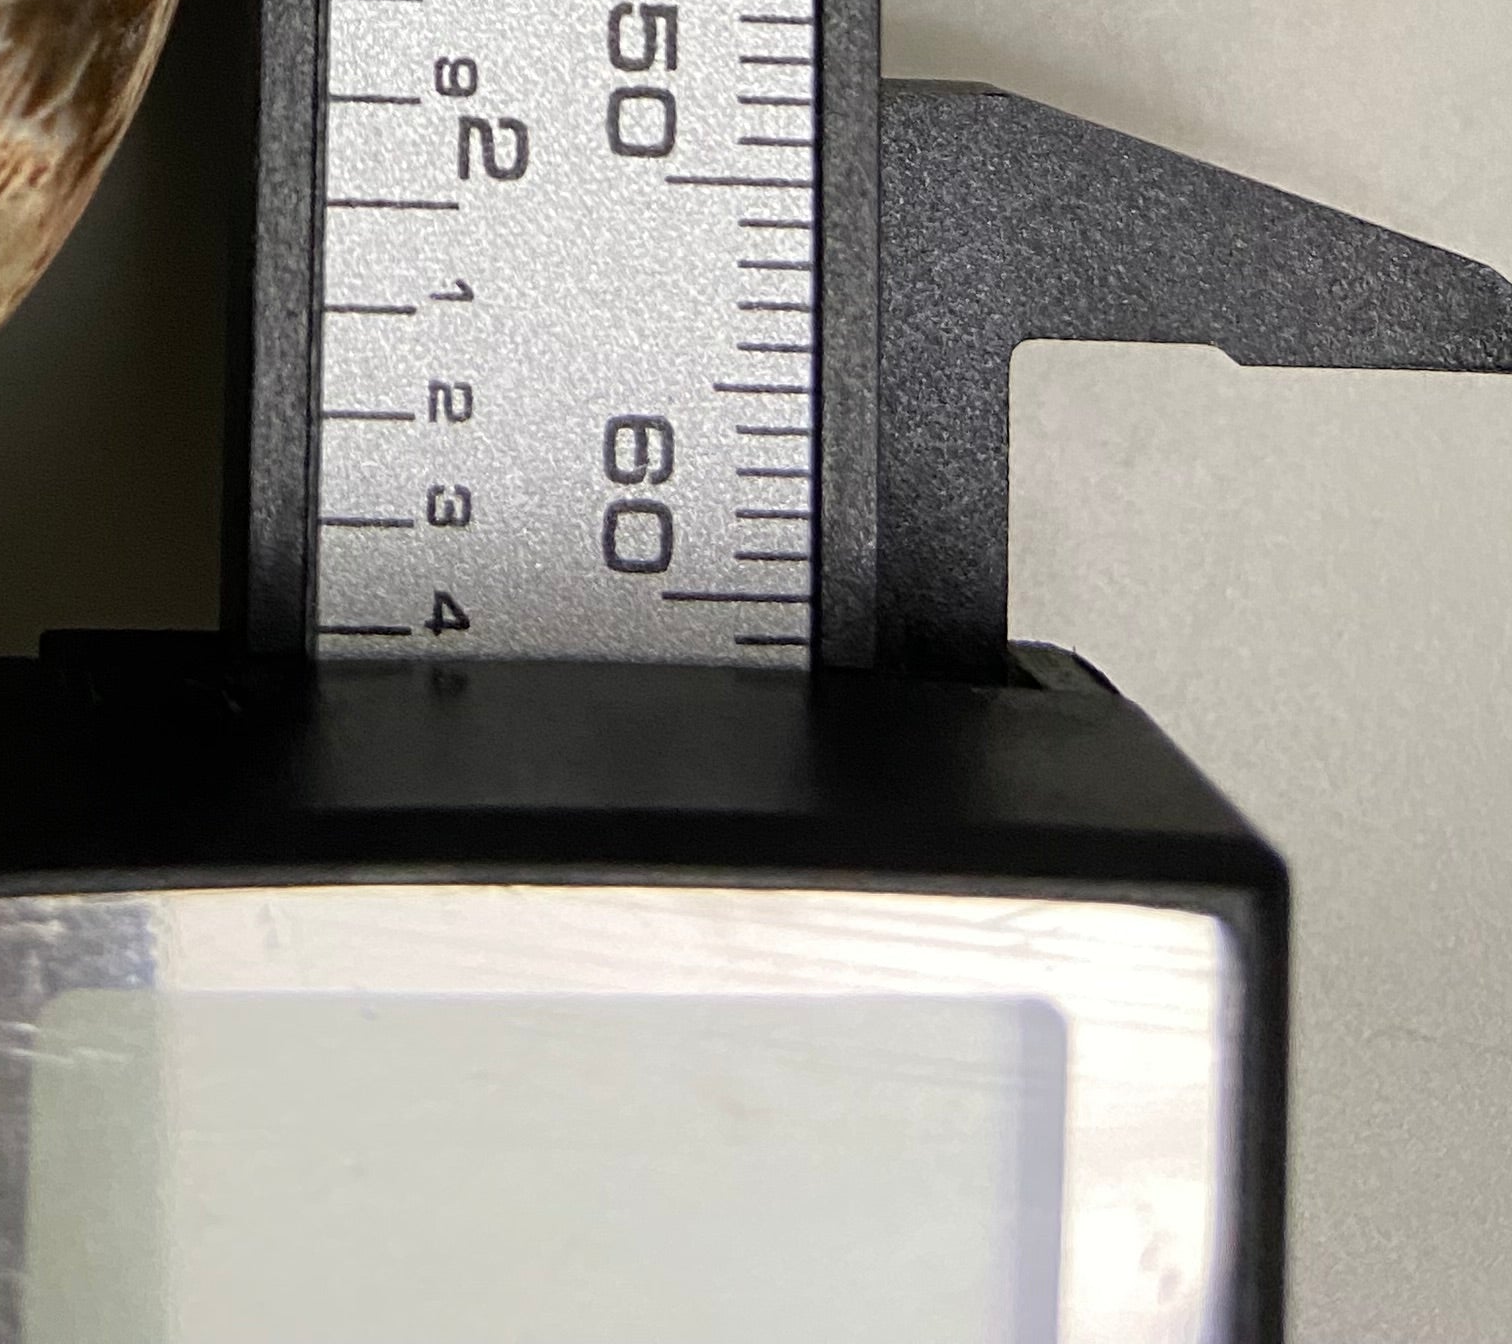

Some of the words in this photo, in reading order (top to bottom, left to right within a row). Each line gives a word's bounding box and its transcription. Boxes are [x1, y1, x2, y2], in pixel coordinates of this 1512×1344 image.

[432, 55, 481, 100] 9
[604, 0, 680, 161] 50
[456, 113, 531, 183] 2
[427, 277, 477, 304] 1
[426, 378, 476, 426] 2
[424, 483, 474, 530] 3
[601, 413, 676, 576] 60
[423, 589, 472, 637] 4
